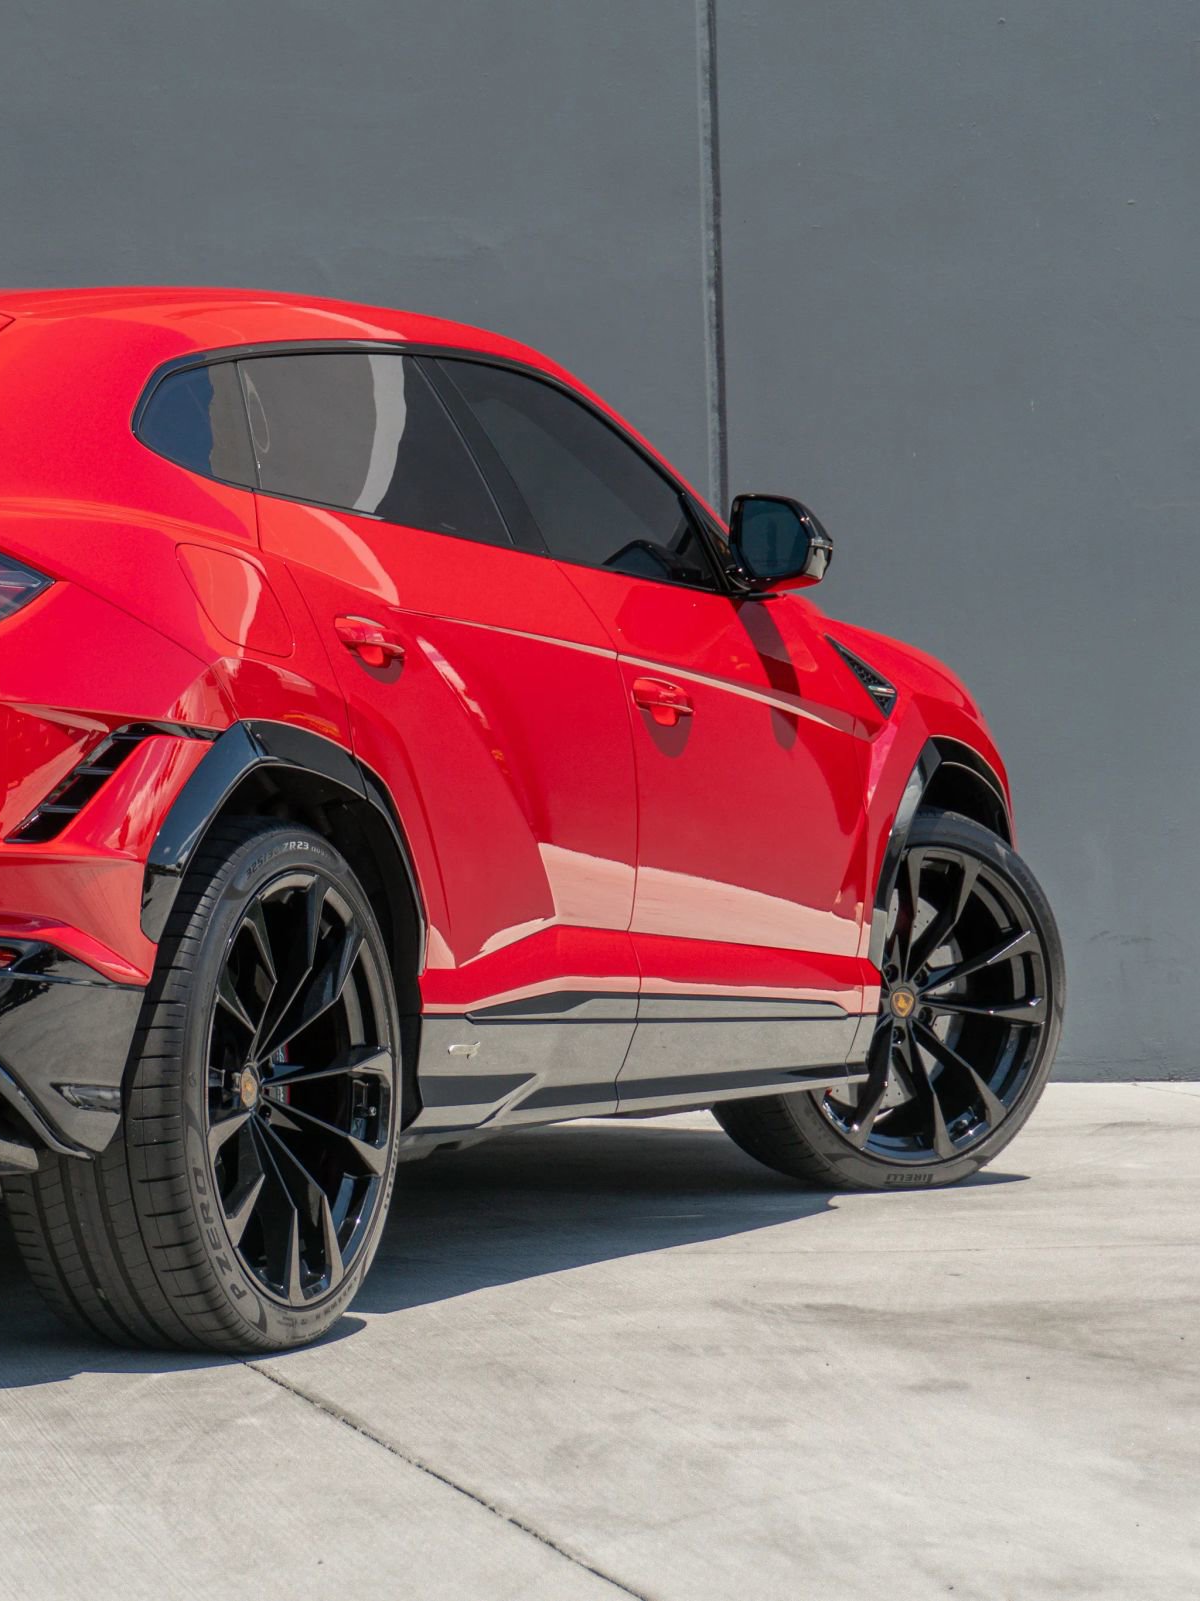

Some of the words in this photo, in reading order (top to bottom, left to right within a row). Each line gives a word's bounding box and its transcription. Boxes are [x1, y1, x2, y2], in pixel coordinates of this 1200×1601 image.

[283, 840, 309, 851] ZR23
[193, 1167, 232, 1275] ZERO
[230, 1284, 247, 1299] P
